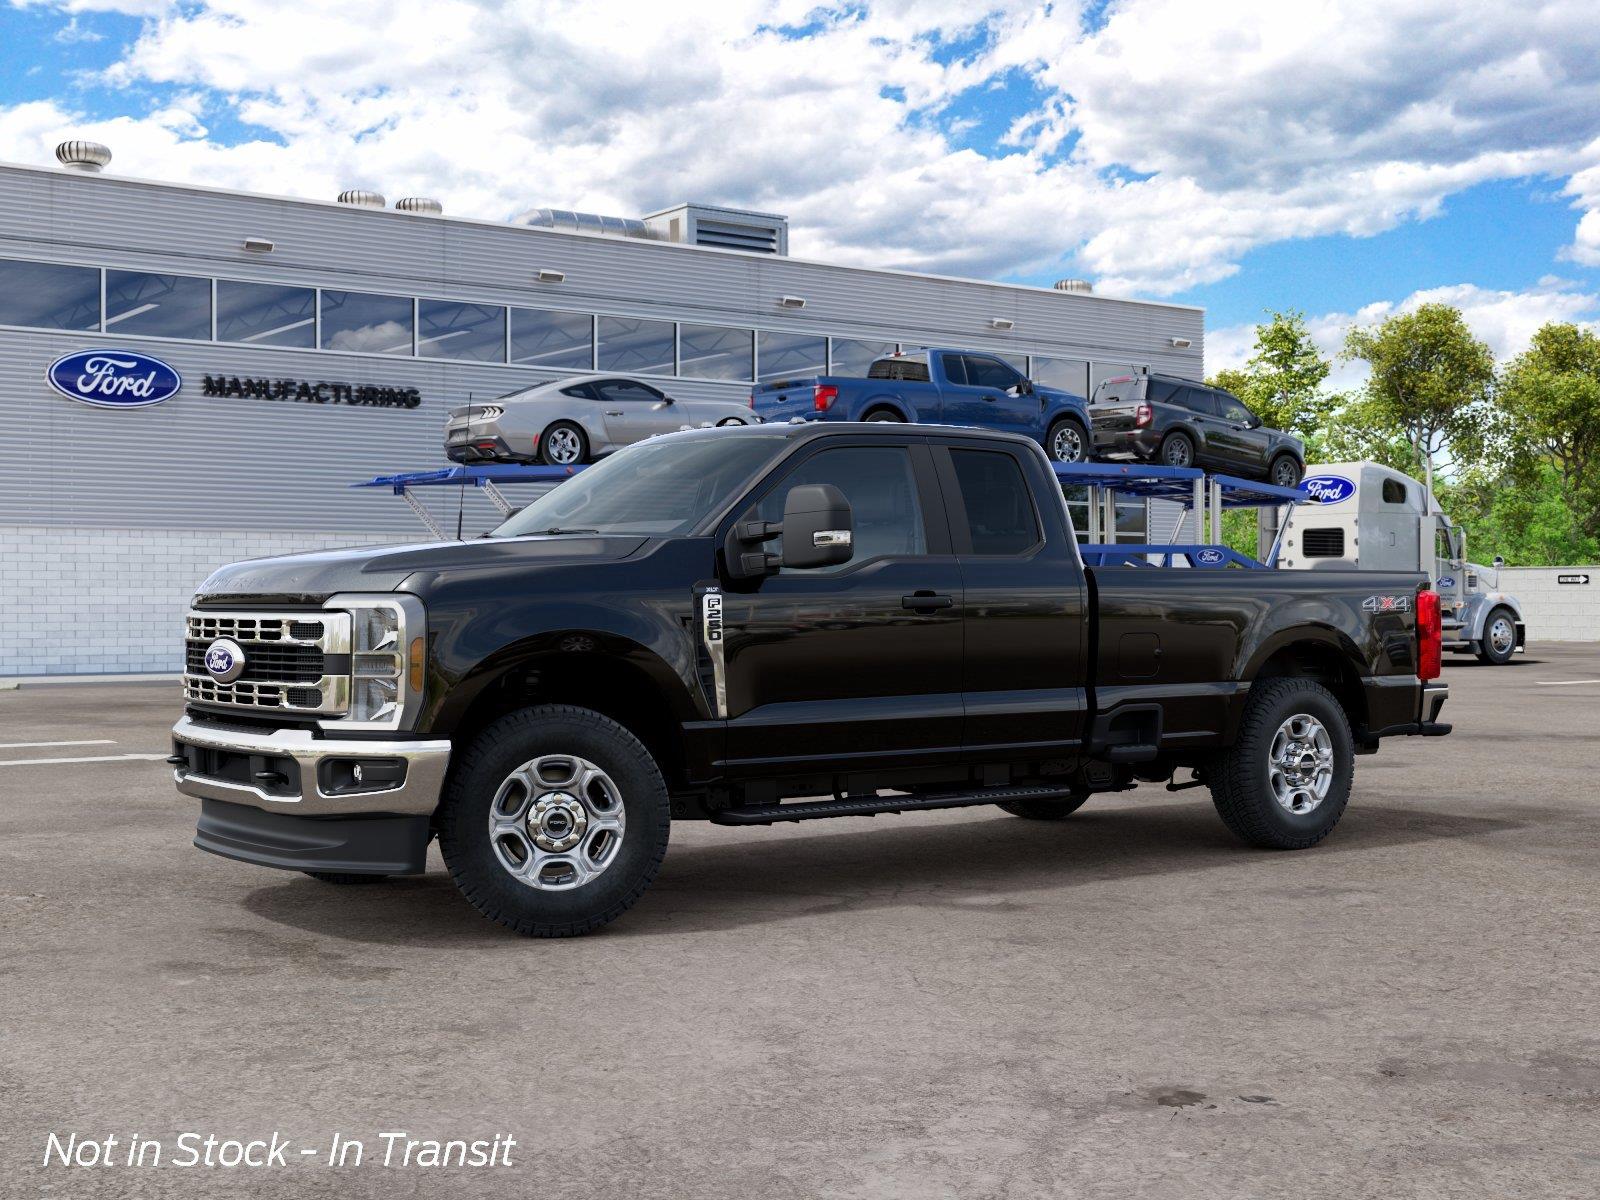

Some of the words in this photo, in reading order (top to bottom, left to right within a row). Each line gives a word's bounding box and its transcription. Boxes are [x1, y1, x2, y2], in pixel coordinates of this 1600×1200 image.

[77, 357, 157, 397] Ford
[203, 375, 421, 408] MANUFACTURING
[1308, 480, 1343, 500] Ford
[1201, 551, 1219, 561] Ford
[210, 650, 228, 669] Ford
